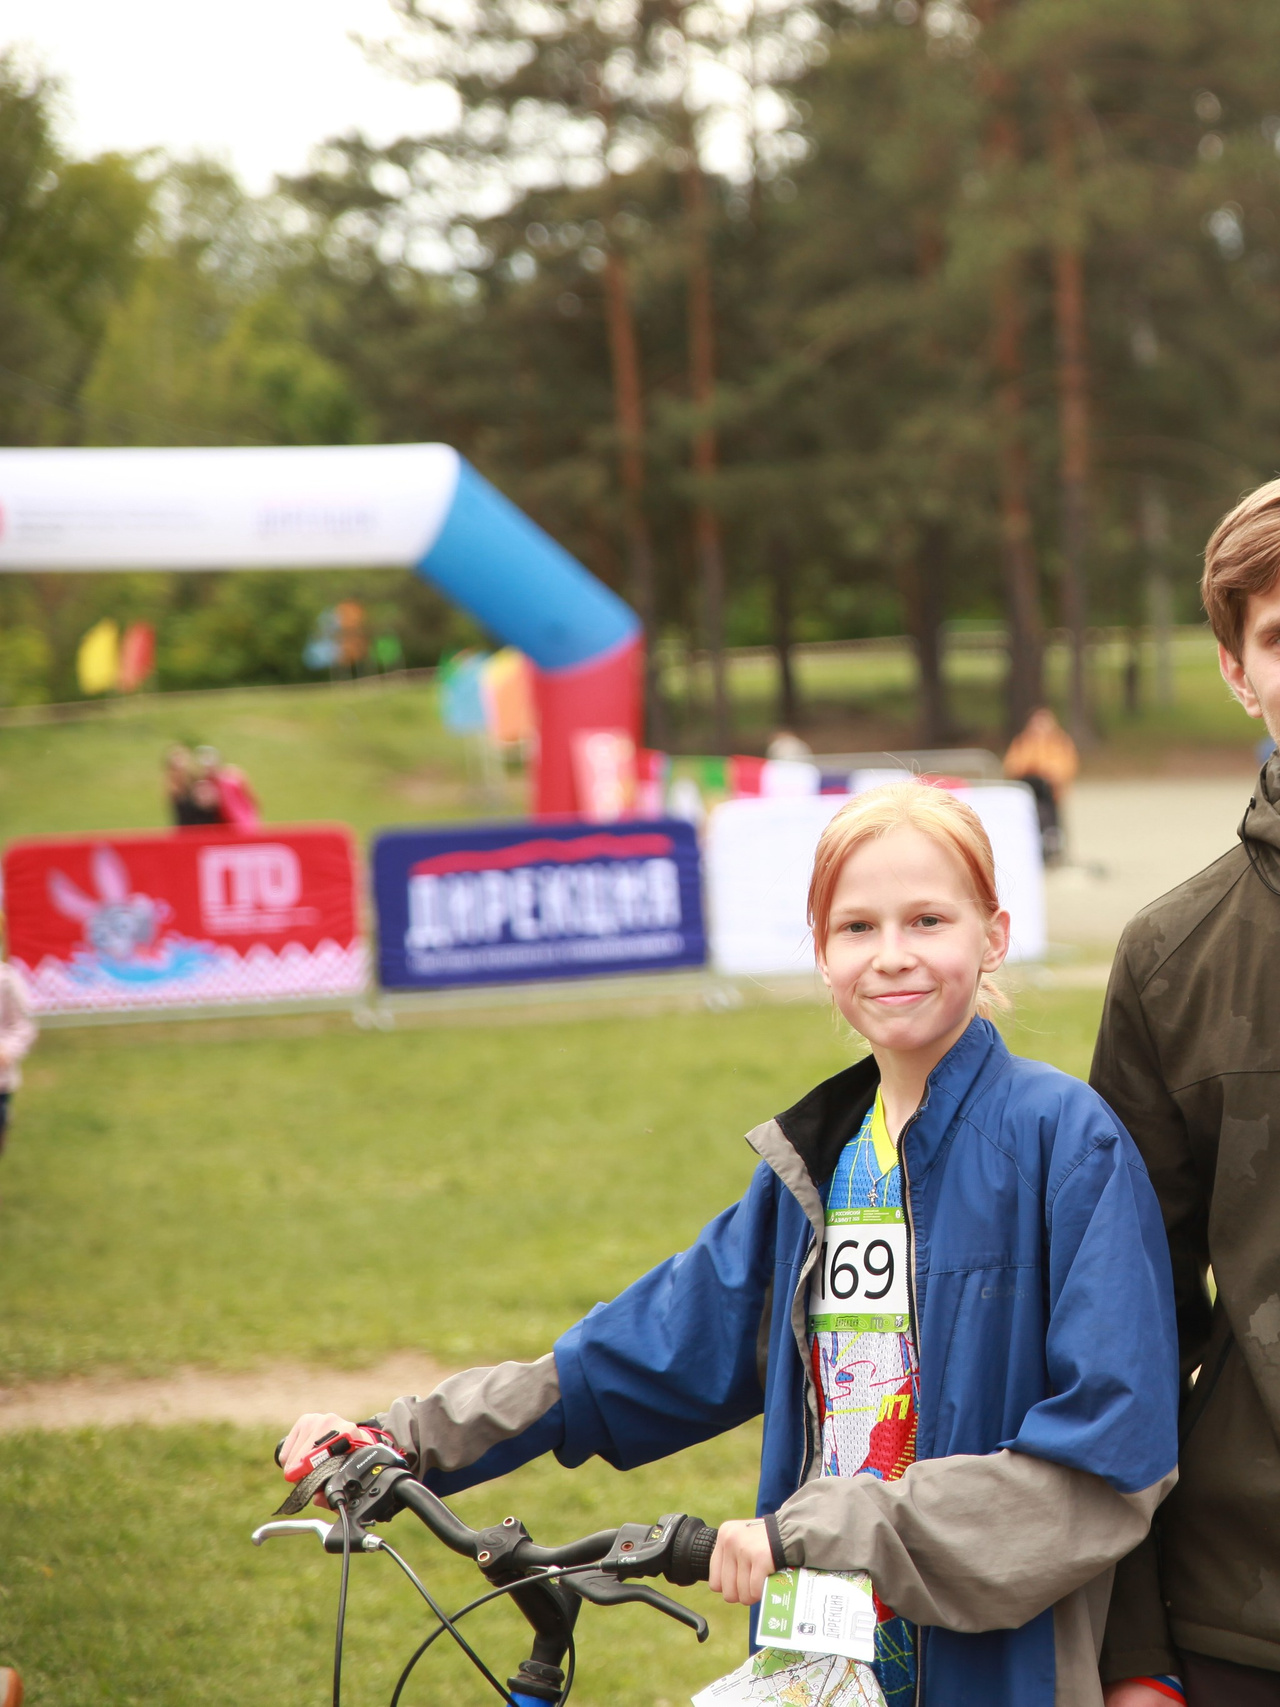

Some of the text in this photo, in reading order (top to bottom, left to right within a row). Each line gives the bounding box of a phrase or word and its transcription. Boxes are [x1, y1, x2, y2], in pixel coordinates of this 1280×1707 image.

[406, 859, 682, 950] ДИРЕКЦИЯ
[821, 1239, 895, 1300] 169
[826, 1594, 844, 1639] ДИРЕКЦИЯ
